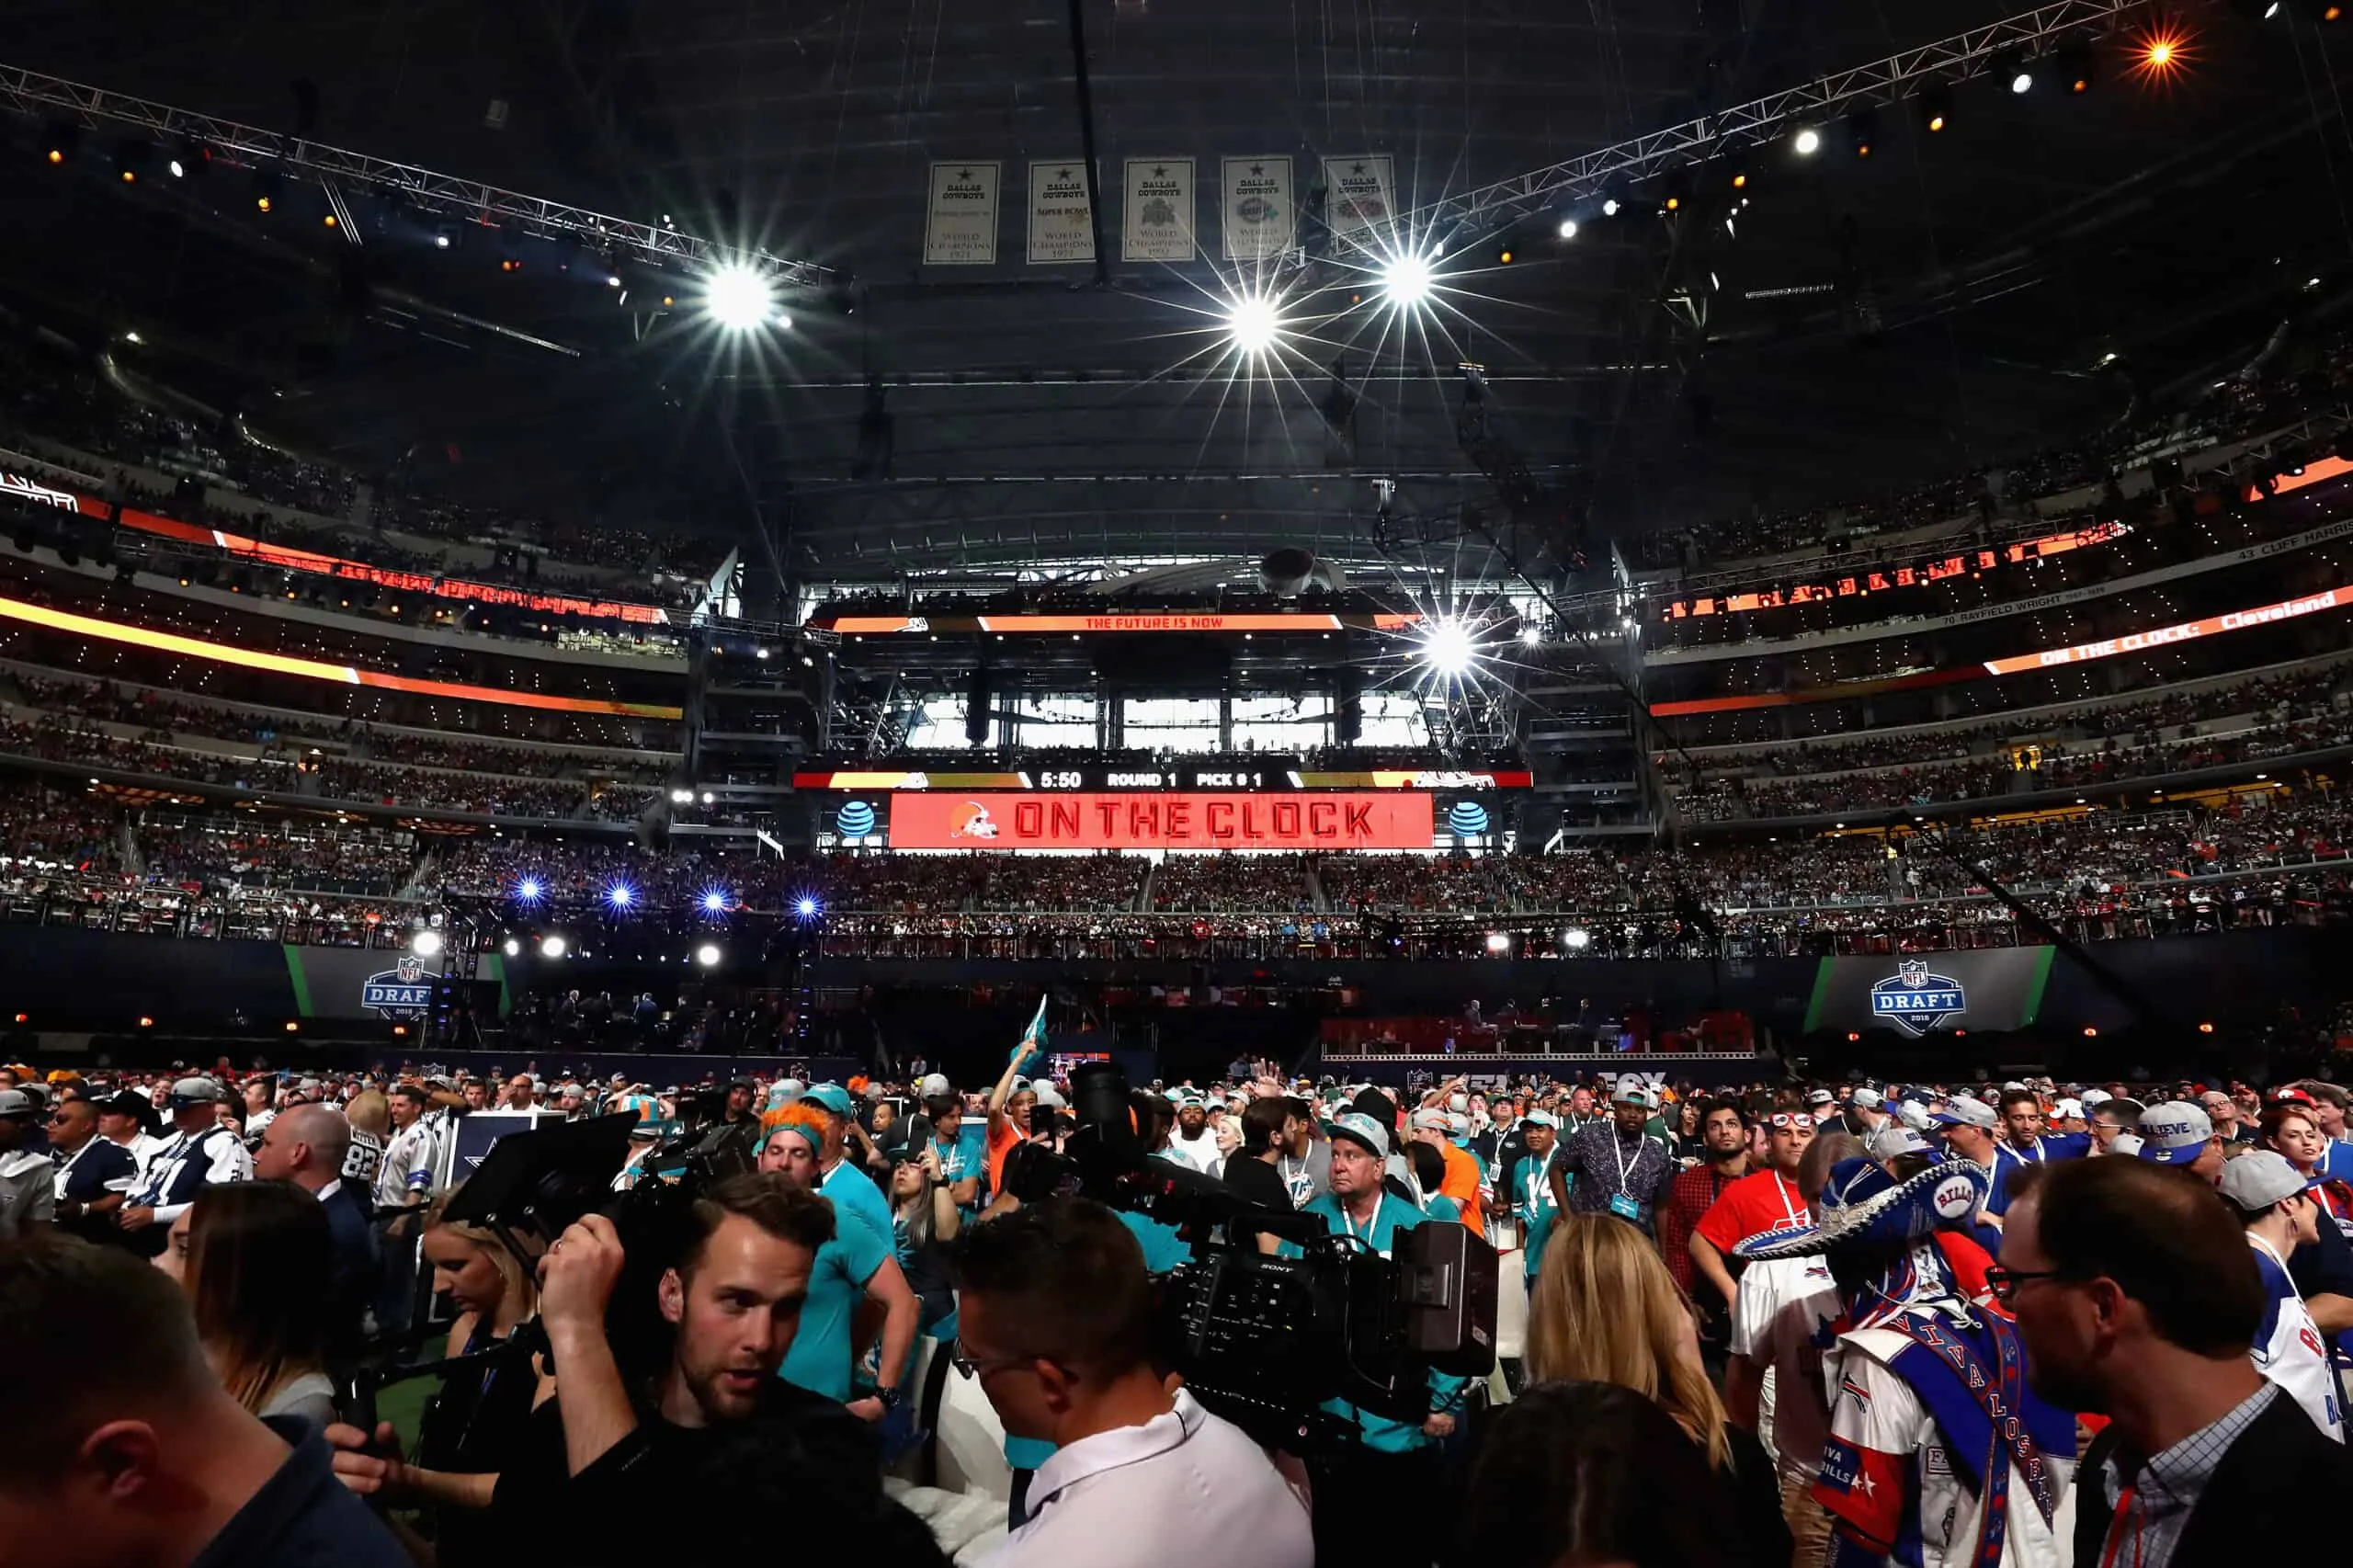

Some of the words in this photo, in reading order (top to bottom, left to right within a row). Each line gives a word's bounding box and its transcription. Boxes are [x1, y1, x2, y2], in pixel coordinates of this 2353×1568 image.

[1342, 177, 1377, 186] DALLAS
[942, 191, 985, 200] COWBOYS
[1042, 190, 1086, 199] COWBOYS
[1235, 187, 1279, 195] COWBOYS
[2261, 537, 2300, 555] CLIFF
[2304, 521, 2353, 544] HARRIS
[1942, 616, 1956, 625] 70
[1960, 604, 2014, 623] RAYFIELD
[2017, 594, 2063, 612] WRIGHT
[1086, 618, 1111, 629] THE
[1116, 618, 1170, 629] FUTURE
[1174, 618, 1188, 629] IS
[1191, 617, 1223, 629] NOW
[2040, 648, 2071, 666] ON
[2077, 640, 2117, 660] THE
[2121, 624, 2201, 652] CLOCK:
[2220, 590, 2336, 631] Cleveland
[1040, 771, 1083, 789] 5:50
[1107, 772, 1162, 788] ROUND
[1167, 772, 1177, 788] 1
[1196, 772, 1233, 787] PICK
[1252, 772, 1262, 788] 1
[1014, 801, 1081, 840] ON
[1096, 801, 1191, 840] THE
[1206, 800, 1376, 841] CLOCK
[1903, 971, 1926, 985] NFL
[369, 988, 430, 1003] DRAF
[1880, 993, 1957, 1009] DRAFT
[1937, 1185, 1972, 1209] BILLS
[1259, 1263, 1294, 1273] SONY
[1889, 1314, 1985, 1388] VIVA
[1990, 1393, 2030, 1458] LOS
[1824, 1445, 1842, 1463] IVA
